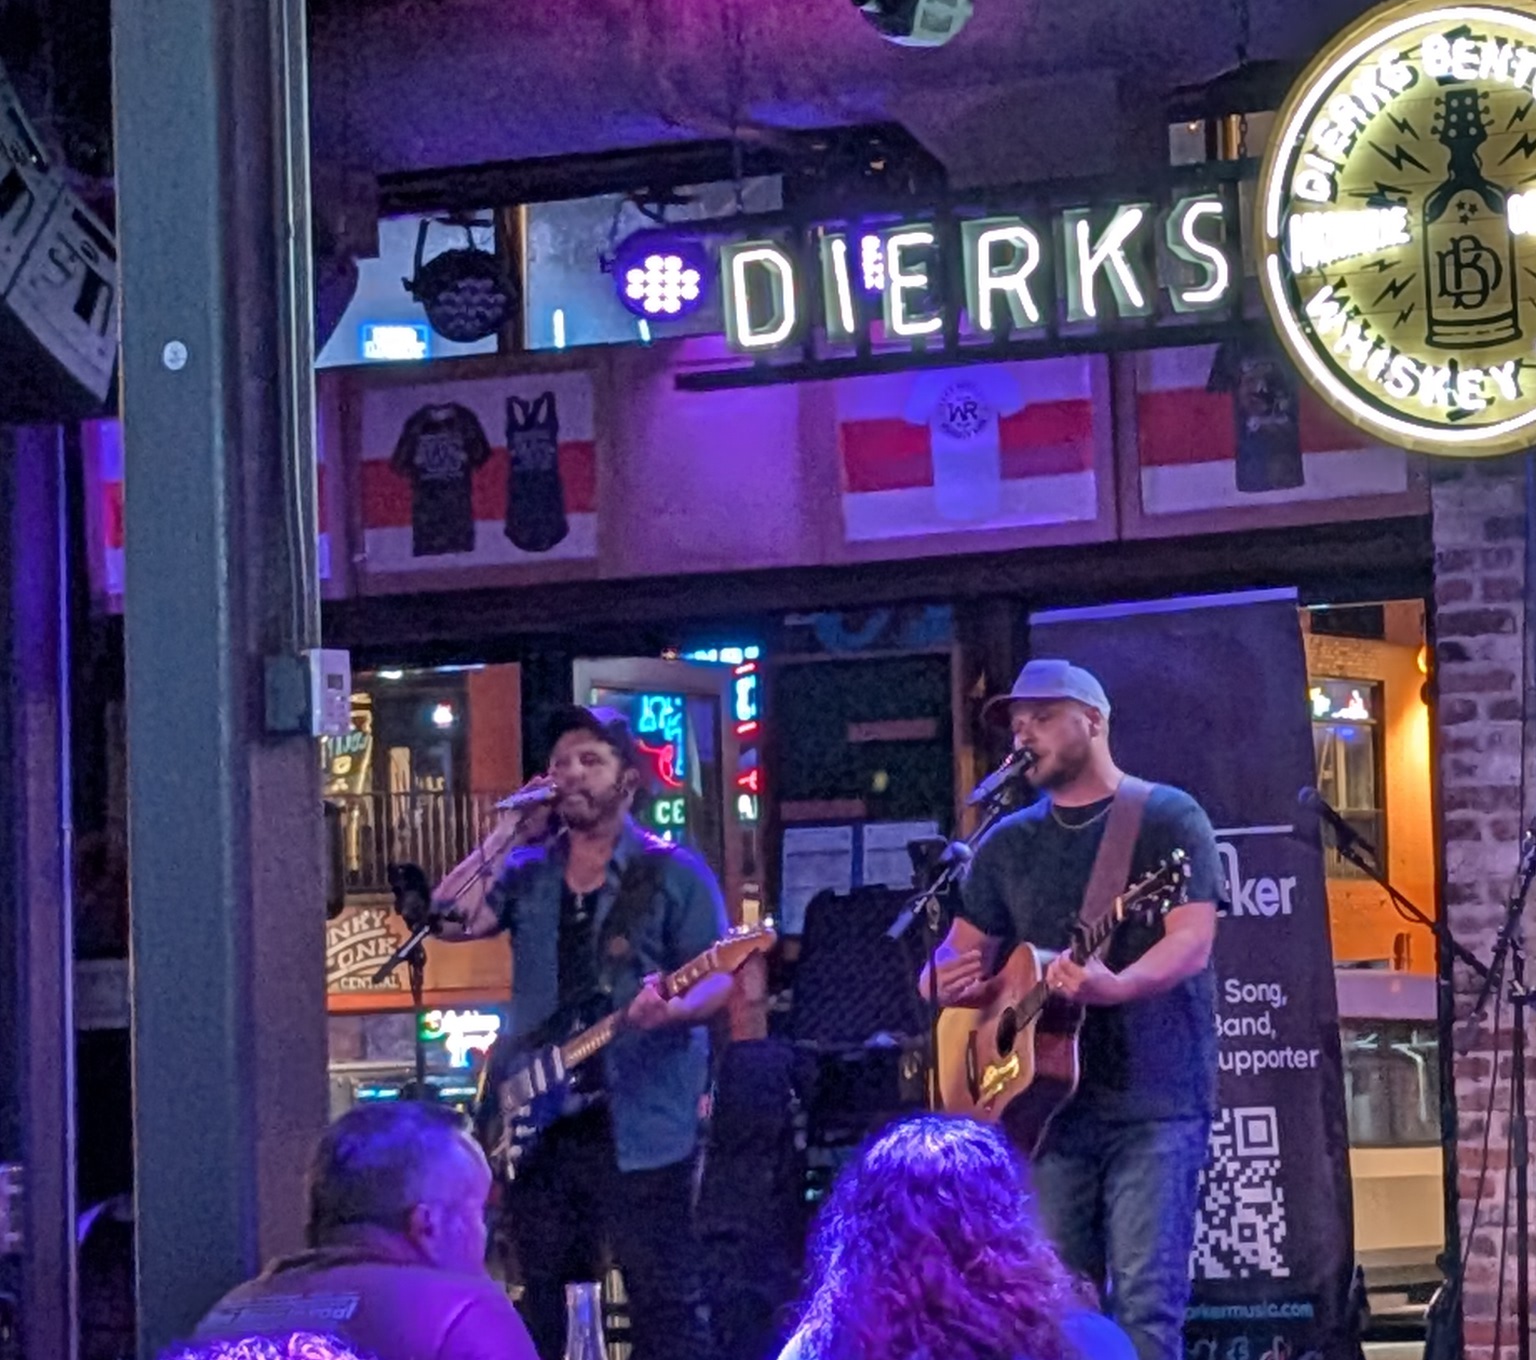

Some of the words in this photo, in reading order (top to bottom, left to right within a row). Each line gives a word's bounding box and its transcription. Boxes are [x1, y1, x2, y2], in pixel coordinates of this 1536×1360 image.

[1293, 46, 1418, 204] DIERKS
[722, 196, 1231, 350] DIERKS
[1304, 276, 1522, 412] WHISKEY
[327, 937, 397, 968] ONK
[1225, 978, 1288, 1008] Song,
[1218, 1048, 1320, 1075] upporter
